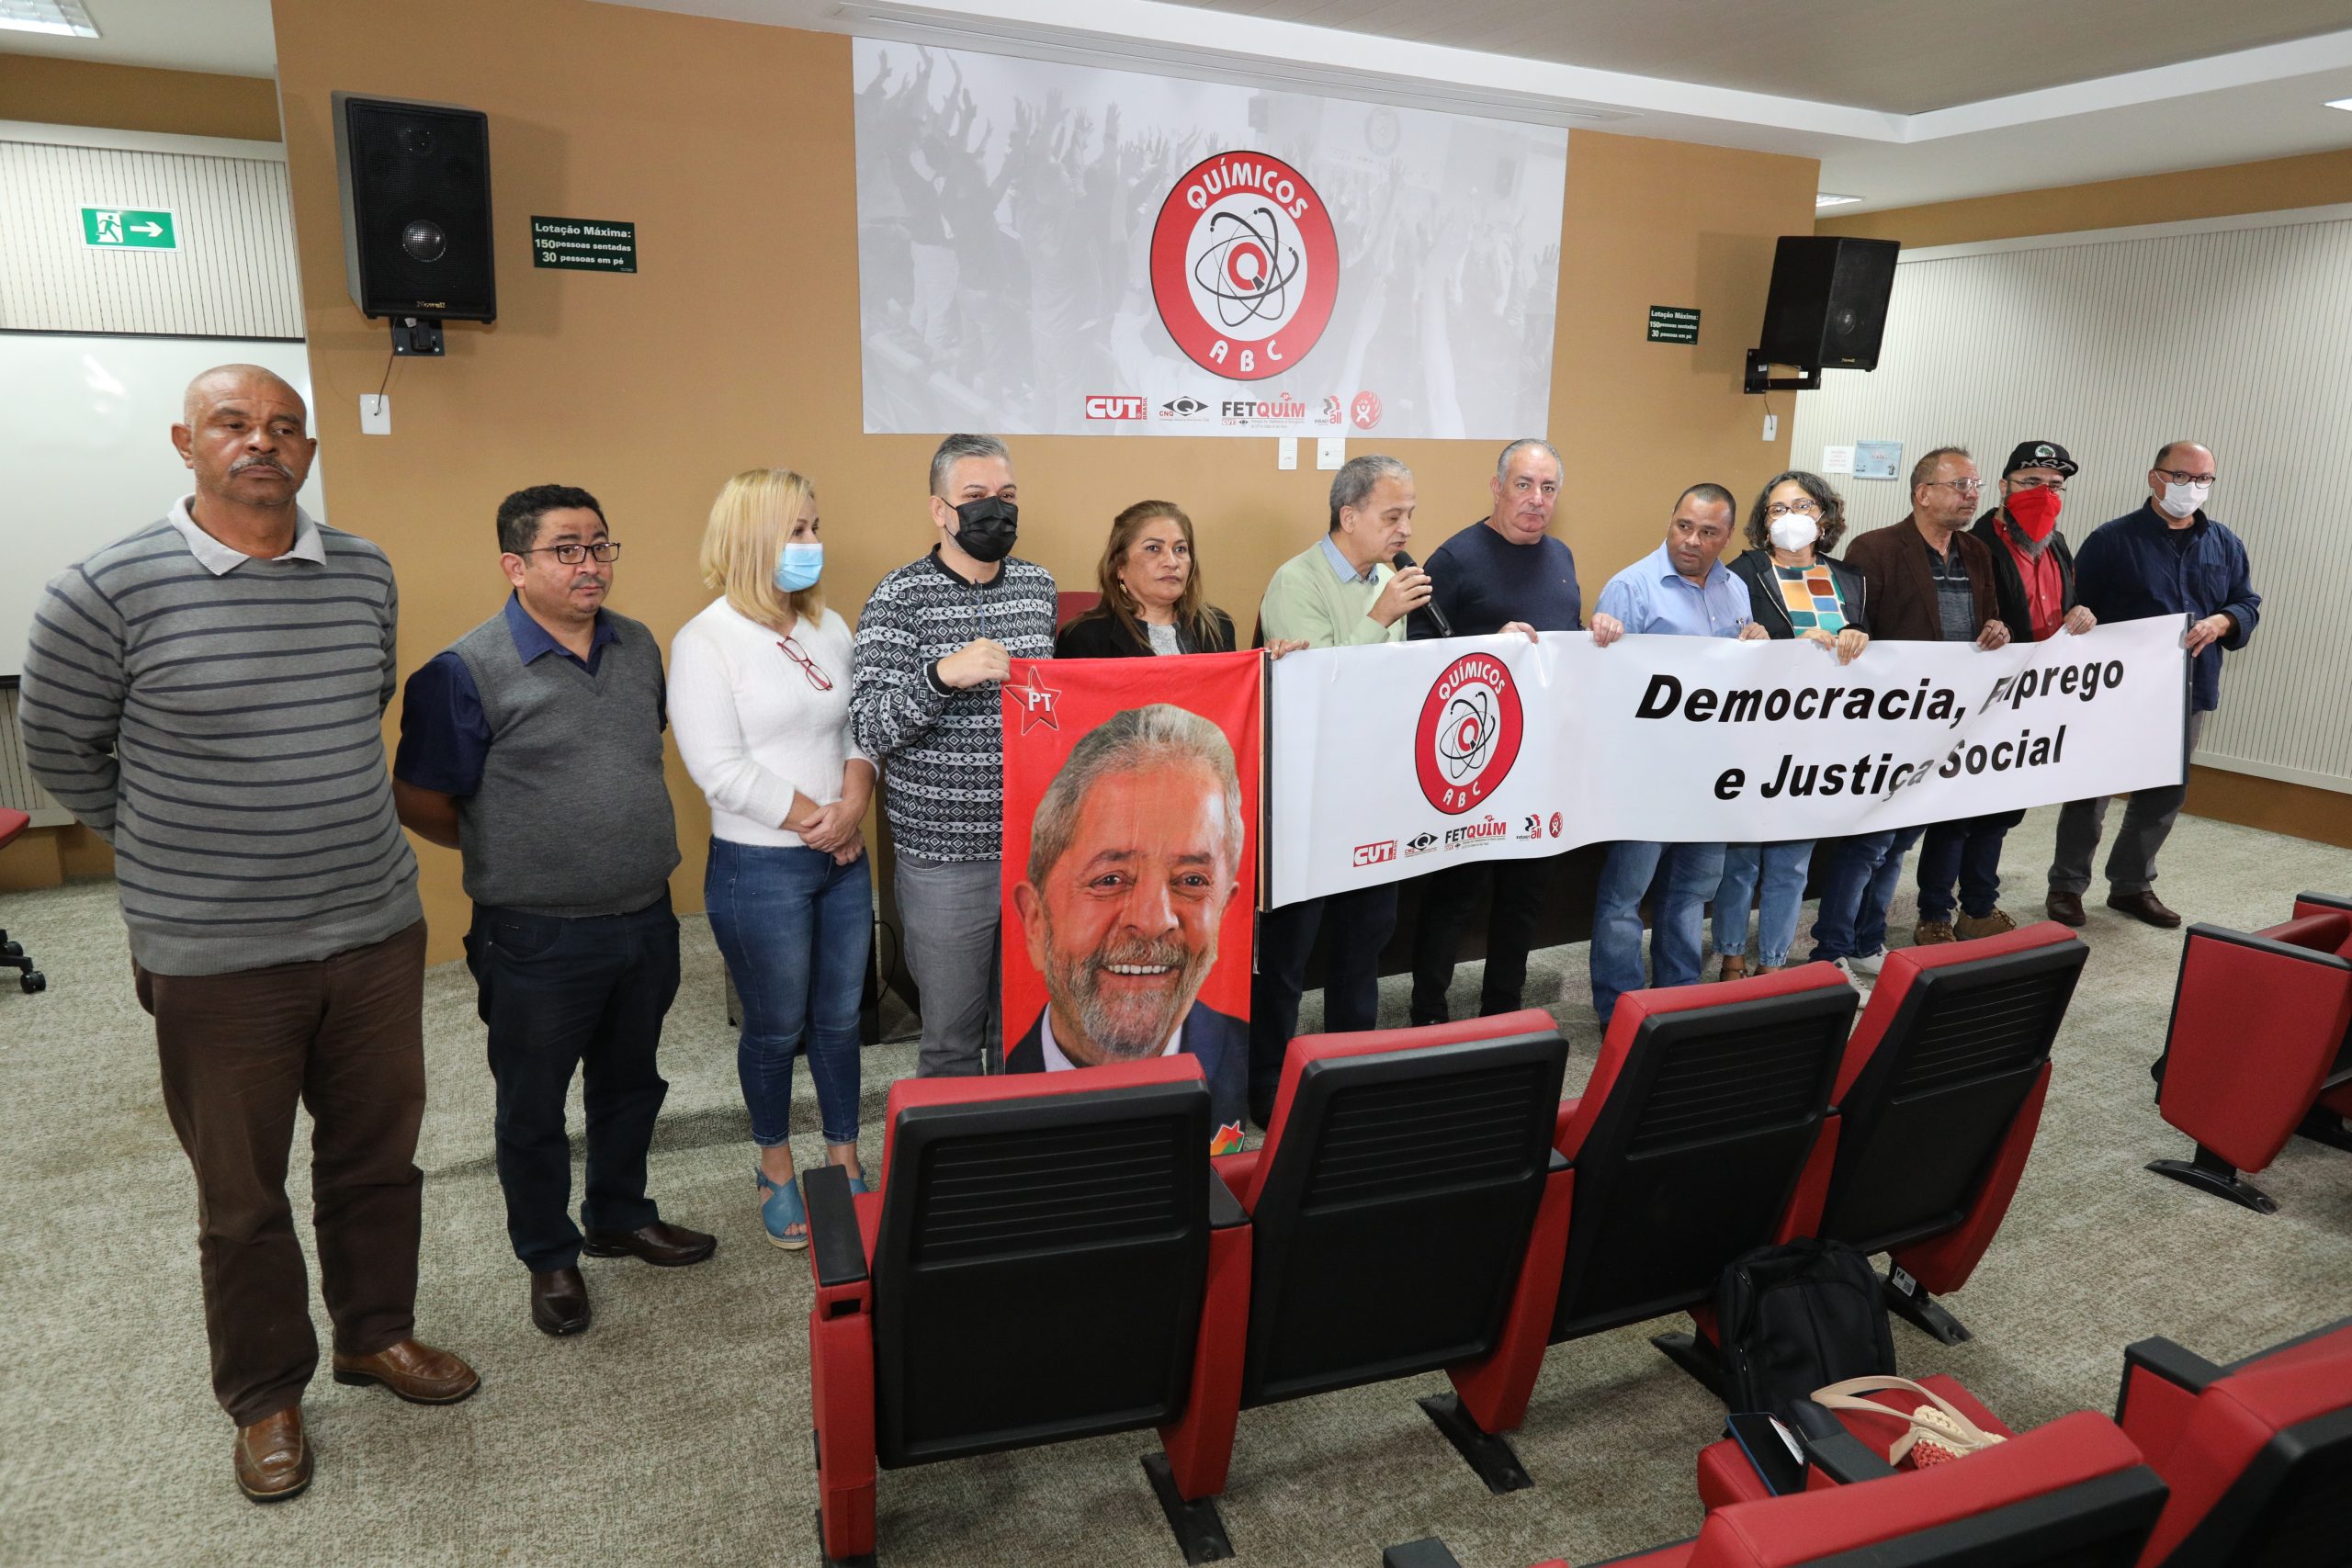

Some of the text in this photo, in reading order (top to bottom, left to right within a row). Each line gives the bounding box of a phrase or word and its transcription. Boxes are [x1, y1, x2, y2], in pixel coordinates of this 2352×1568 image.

[1187, 157, 1308, 219] QUÍMICOS
[535, 222, 632, 238] Lotação Máxima:
[535, 239, 632, 252] 150 pessoas sentadas
[542, 252, 557, 263] 30
[560, 254, 595, 263] pessoas
[613, 257, 624, 265] pé
[1651, 310, 1699, 321] Lotação Máxima:
[1086, 398, 1141, 419] CUT
[1222, 401, 1306, 418] FETQUIM
[2020, 459, 2075, 471] MST
[1439, 660, 1505, 700] QUÍMICOS
[1028, 692, 1052, 712] PT
[1635, 673, 1966, 729] Democracia,
[1713, 725, 2067, 803] e Justiça Social
[1444, 822, 1507, 843] FETQUIM
[1354, 842, 1393, 865] CUT
